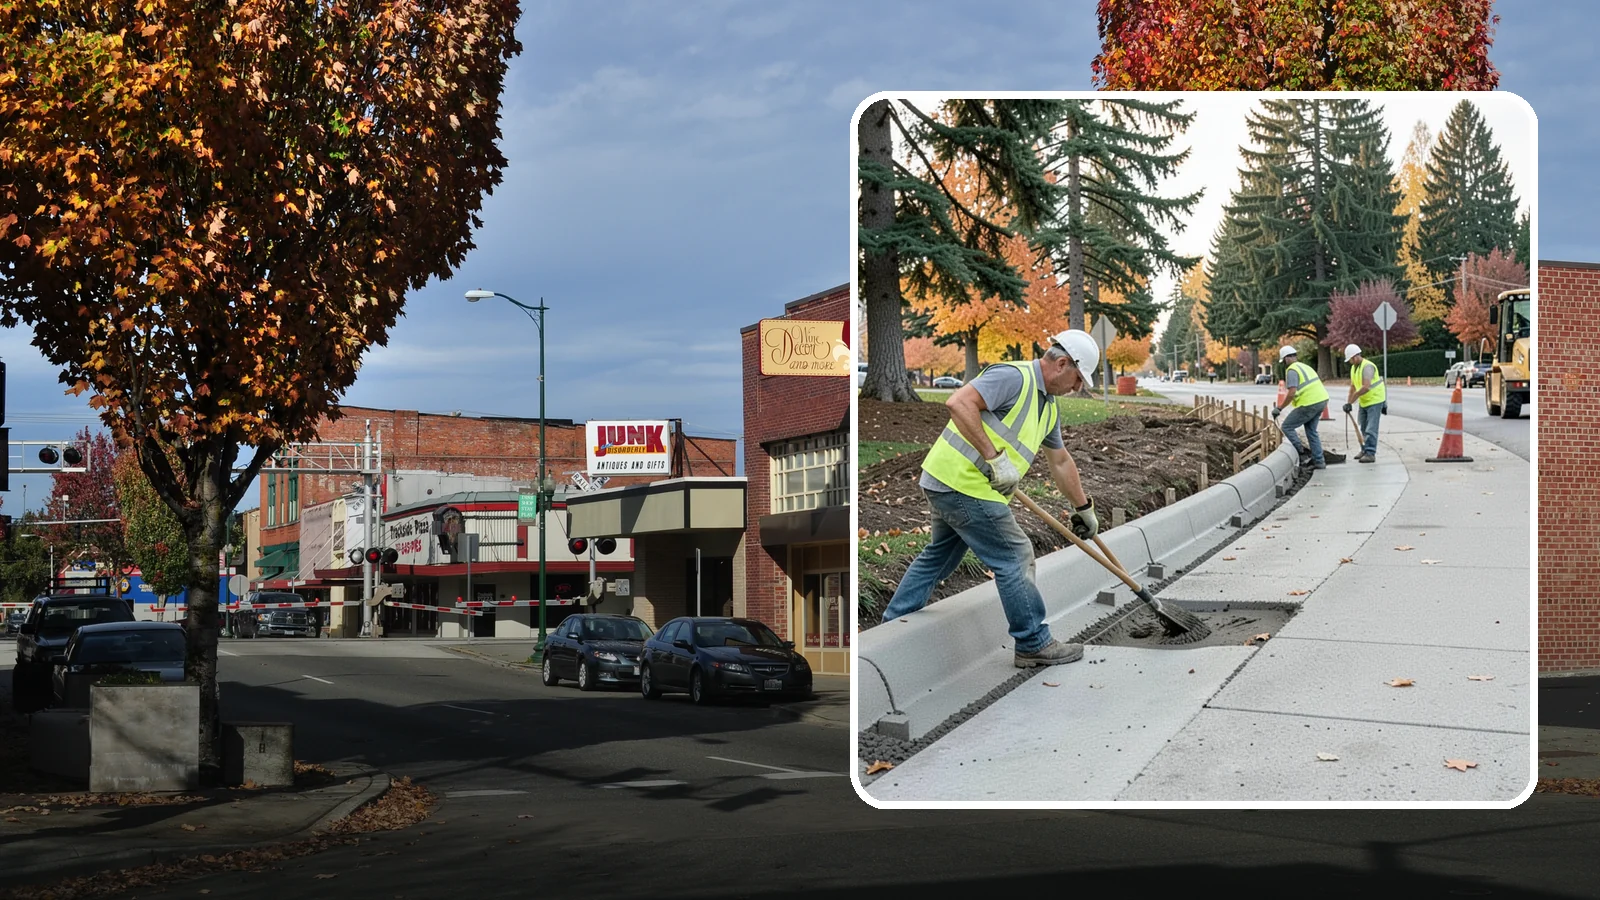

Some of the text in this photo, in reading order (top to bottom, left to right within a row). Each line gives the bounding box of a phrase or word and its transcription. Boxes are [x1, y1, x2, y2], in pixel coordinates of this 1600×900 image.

[595, 425, 664, 457] JUNK
[607, 446, 646, 454] DISORDERLY
[596, 460, 665, 470] ANTIQUES AND GIFTS
[390, 519, 429, 539] Trackside Pizza
